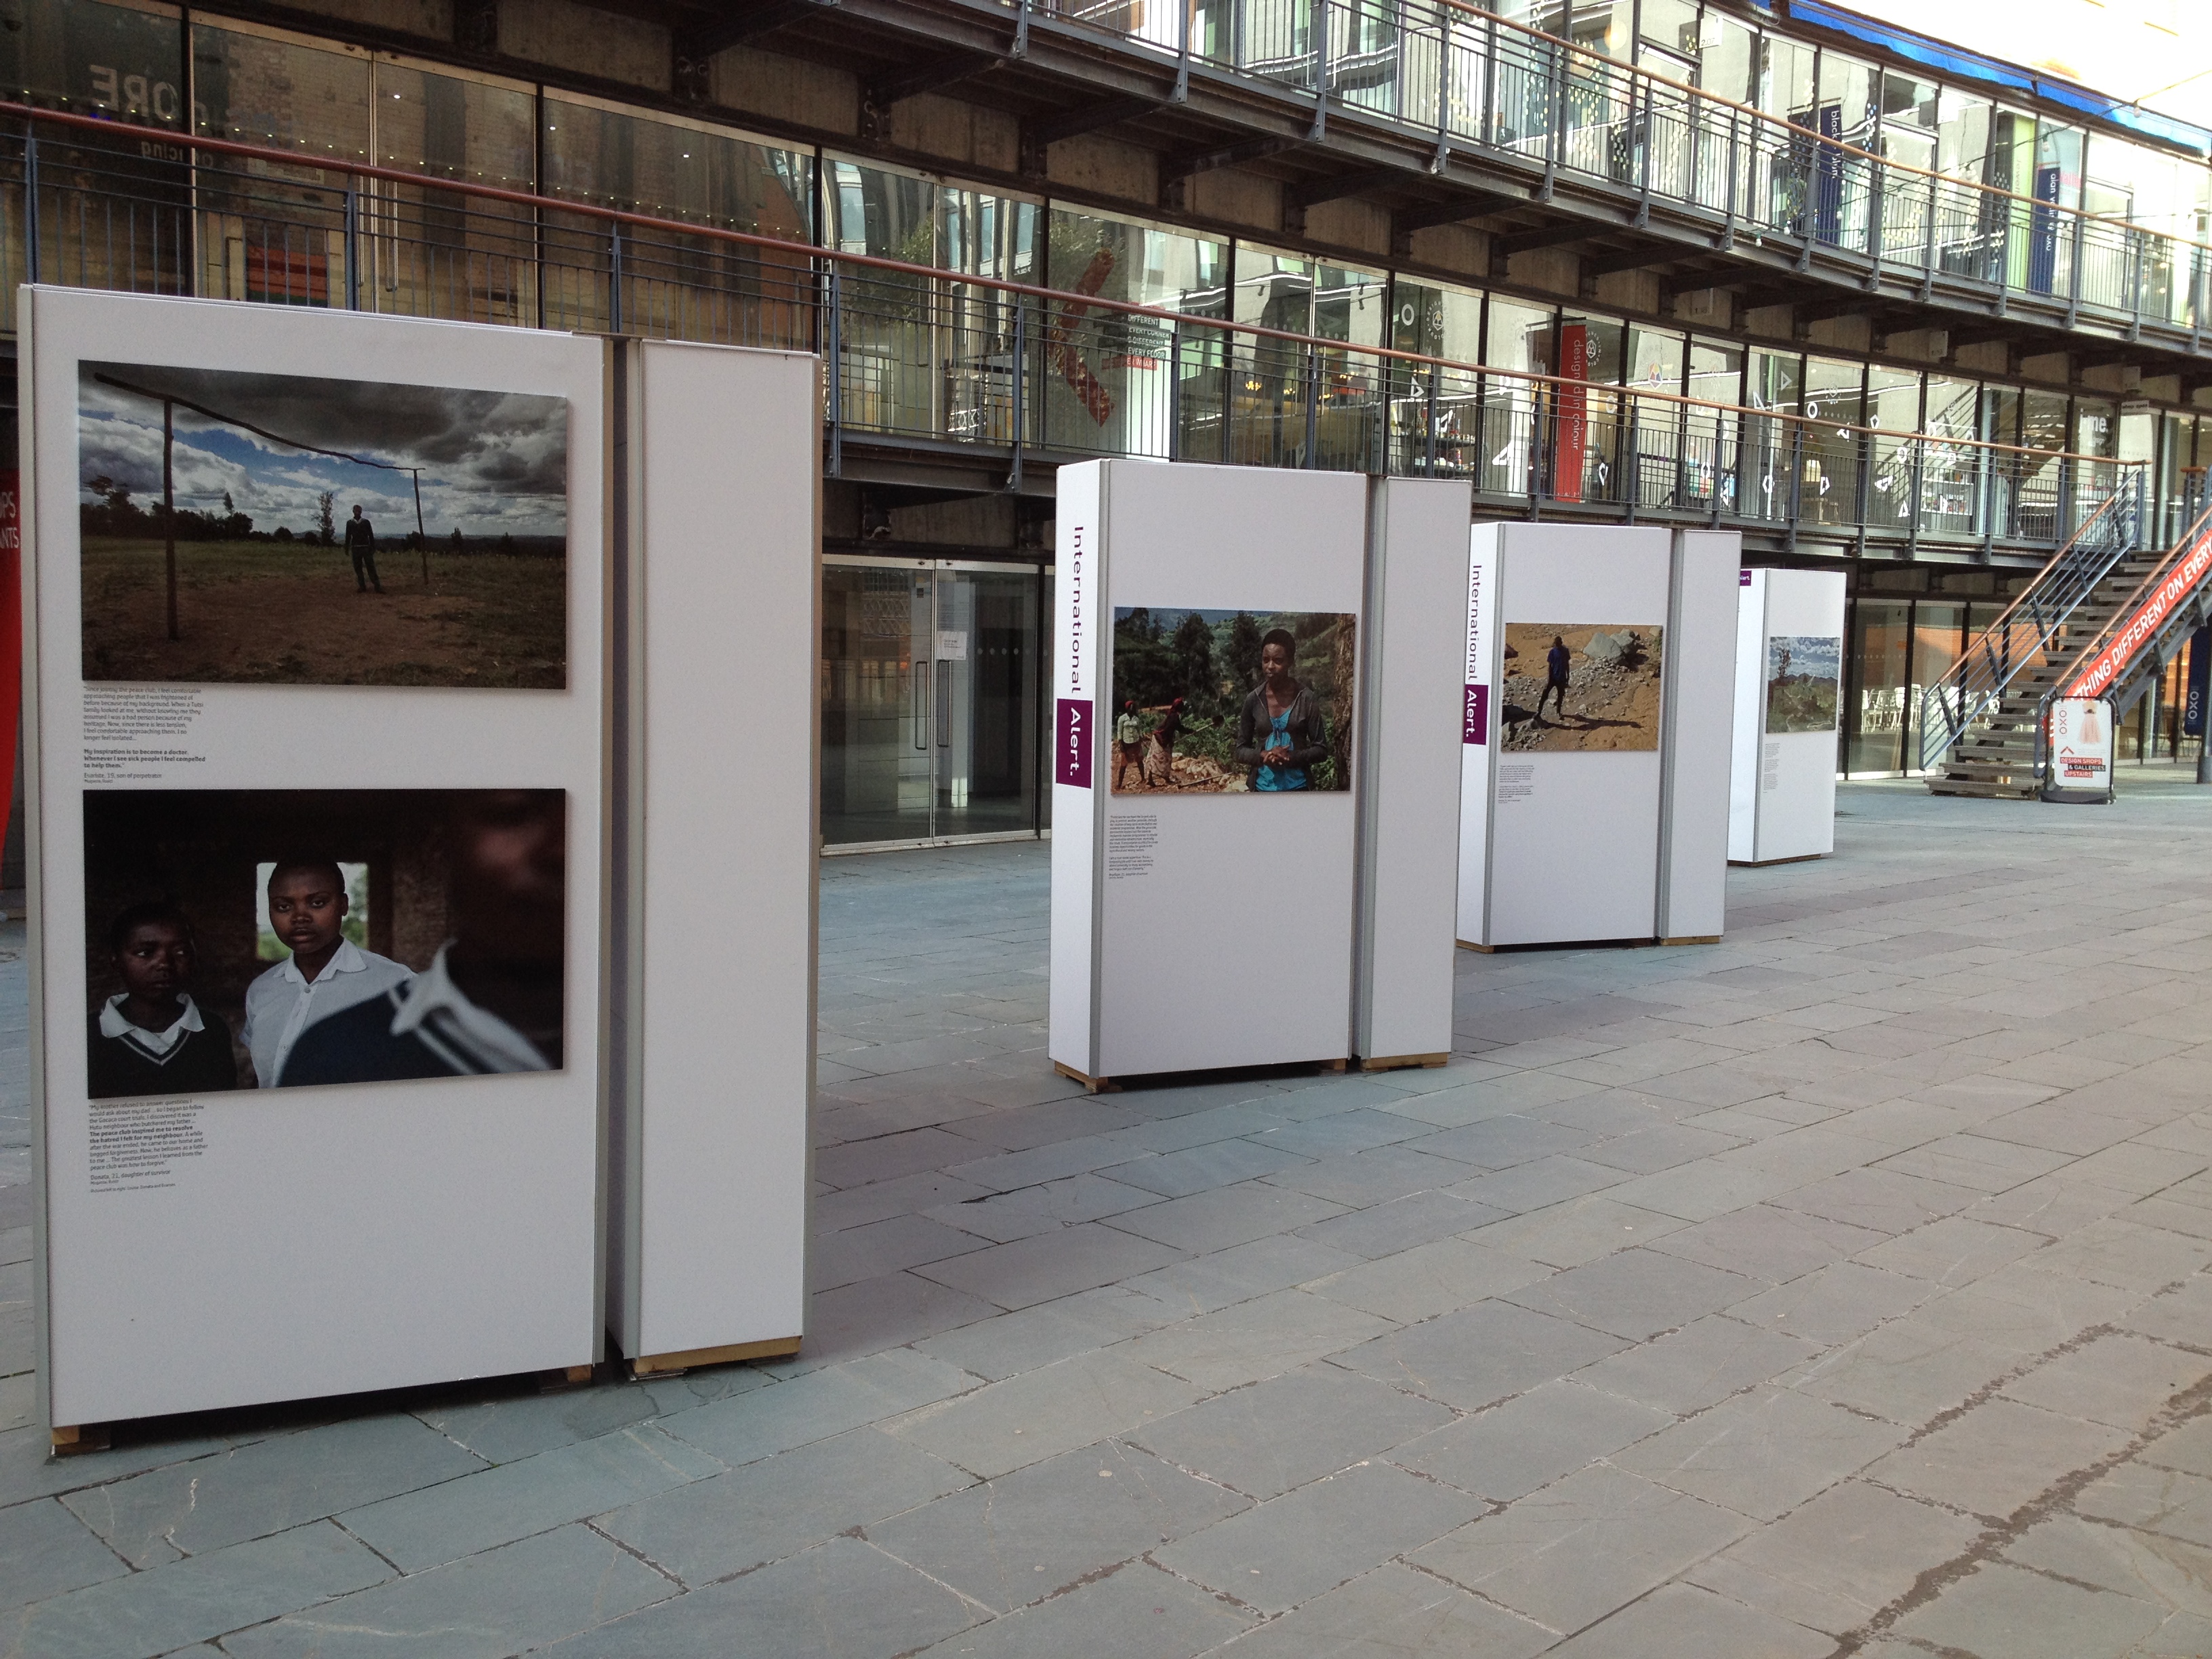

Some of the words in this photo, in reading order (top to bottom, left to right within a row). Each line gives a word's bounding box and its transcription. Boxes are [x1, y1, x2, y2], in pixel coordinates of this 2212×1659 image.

[1830, 110, 1841, 139] black
[2050, 173, 2059, 193] alan
[1128, 314, 1160, 326] DIFFERENT
[1128, 346, 1146, 356] EVERY
[1147, 349, 1165, 359] FLOOR
[1572, 340, 1584, 394] designd
[1071, 526, 1084, 694] International
[2111, 591, 2167, 667] DIFFERENT
[2167, 573, 2184, 600] ON
[2184, 537, 2212, 583] EVERY
[1468, 565, 1482, 680] International
[1466, 689, 1477, 738] Alert.
[2059, 710, 2067, 735] OXO
[2188, 691, 2199, 720] OXO
[1069, 707, 1082, 777] Alert.
